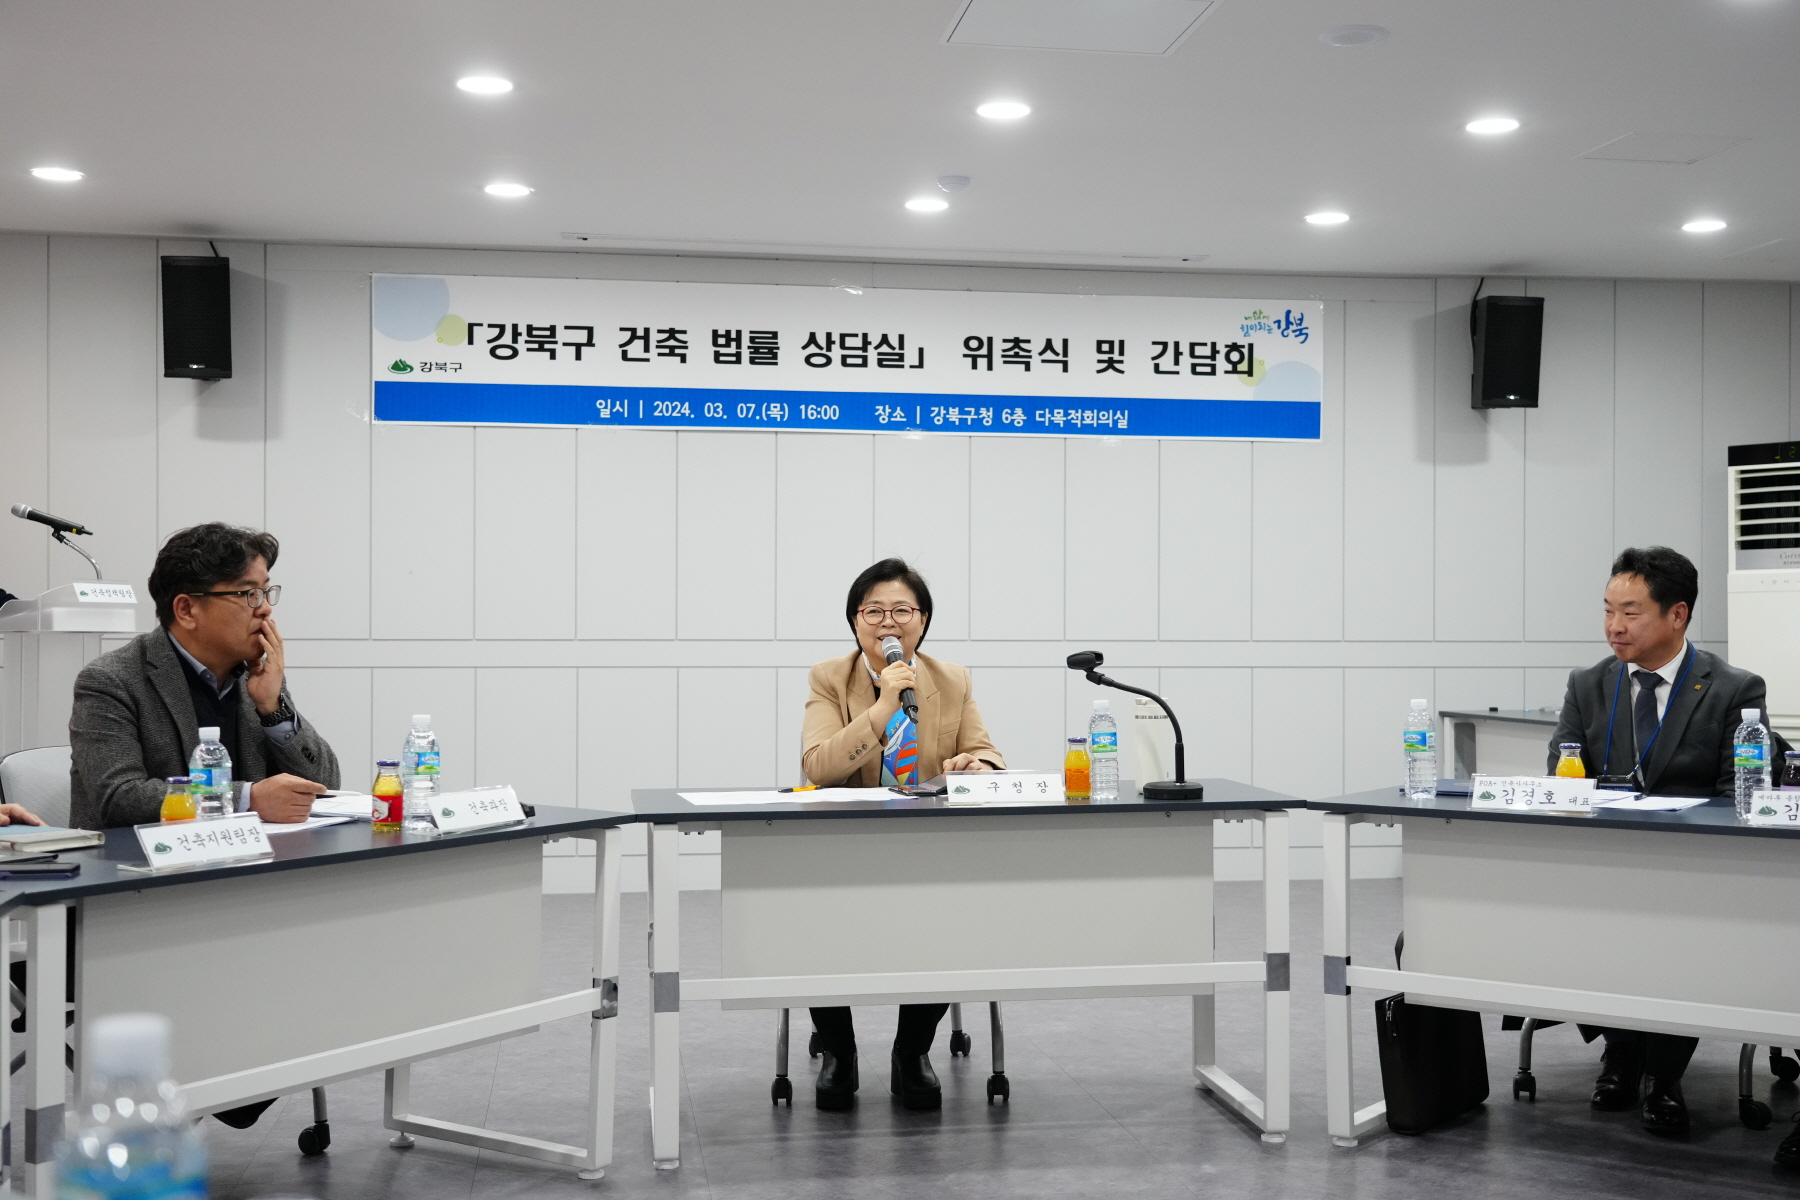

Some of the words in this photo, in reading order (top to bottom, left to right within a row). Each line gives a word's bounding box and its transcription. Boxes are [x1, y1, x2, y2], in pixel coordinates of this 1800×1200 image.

[1273, 309, 1310, 345] 강북
[619, 326, 689, 364] 건축
[712, 328, 781, 366] 법률
[963, 336, 1069, 374] 위촉식
[1096, 340, 1126, 375] 및
[1150, 341, 1255, 378] 간담회
[419, 361, 463, 373] 강북구
[596, 398, 629, 418] 일시
[653, 400, 695, 419] 2024.
[704, 402, 728, 420] 03.
[736, 403, 789, 422] 07.(목)
[799, 404, 840, 421] 16:00
[874, 404, 907, 424] 장소
[929, 405, 993, 427] 강북구청
[1001, 407, 1027, 427] 6층
[1035, 408, 1129, 429] 다목적회의실
[469, 799, 508, 815] 건축과장
[1568, 796, 1590, 806] 대표
[1783, 803, 1800, 821] 김
[176, 826, 261, 851] 건축지원팀장
